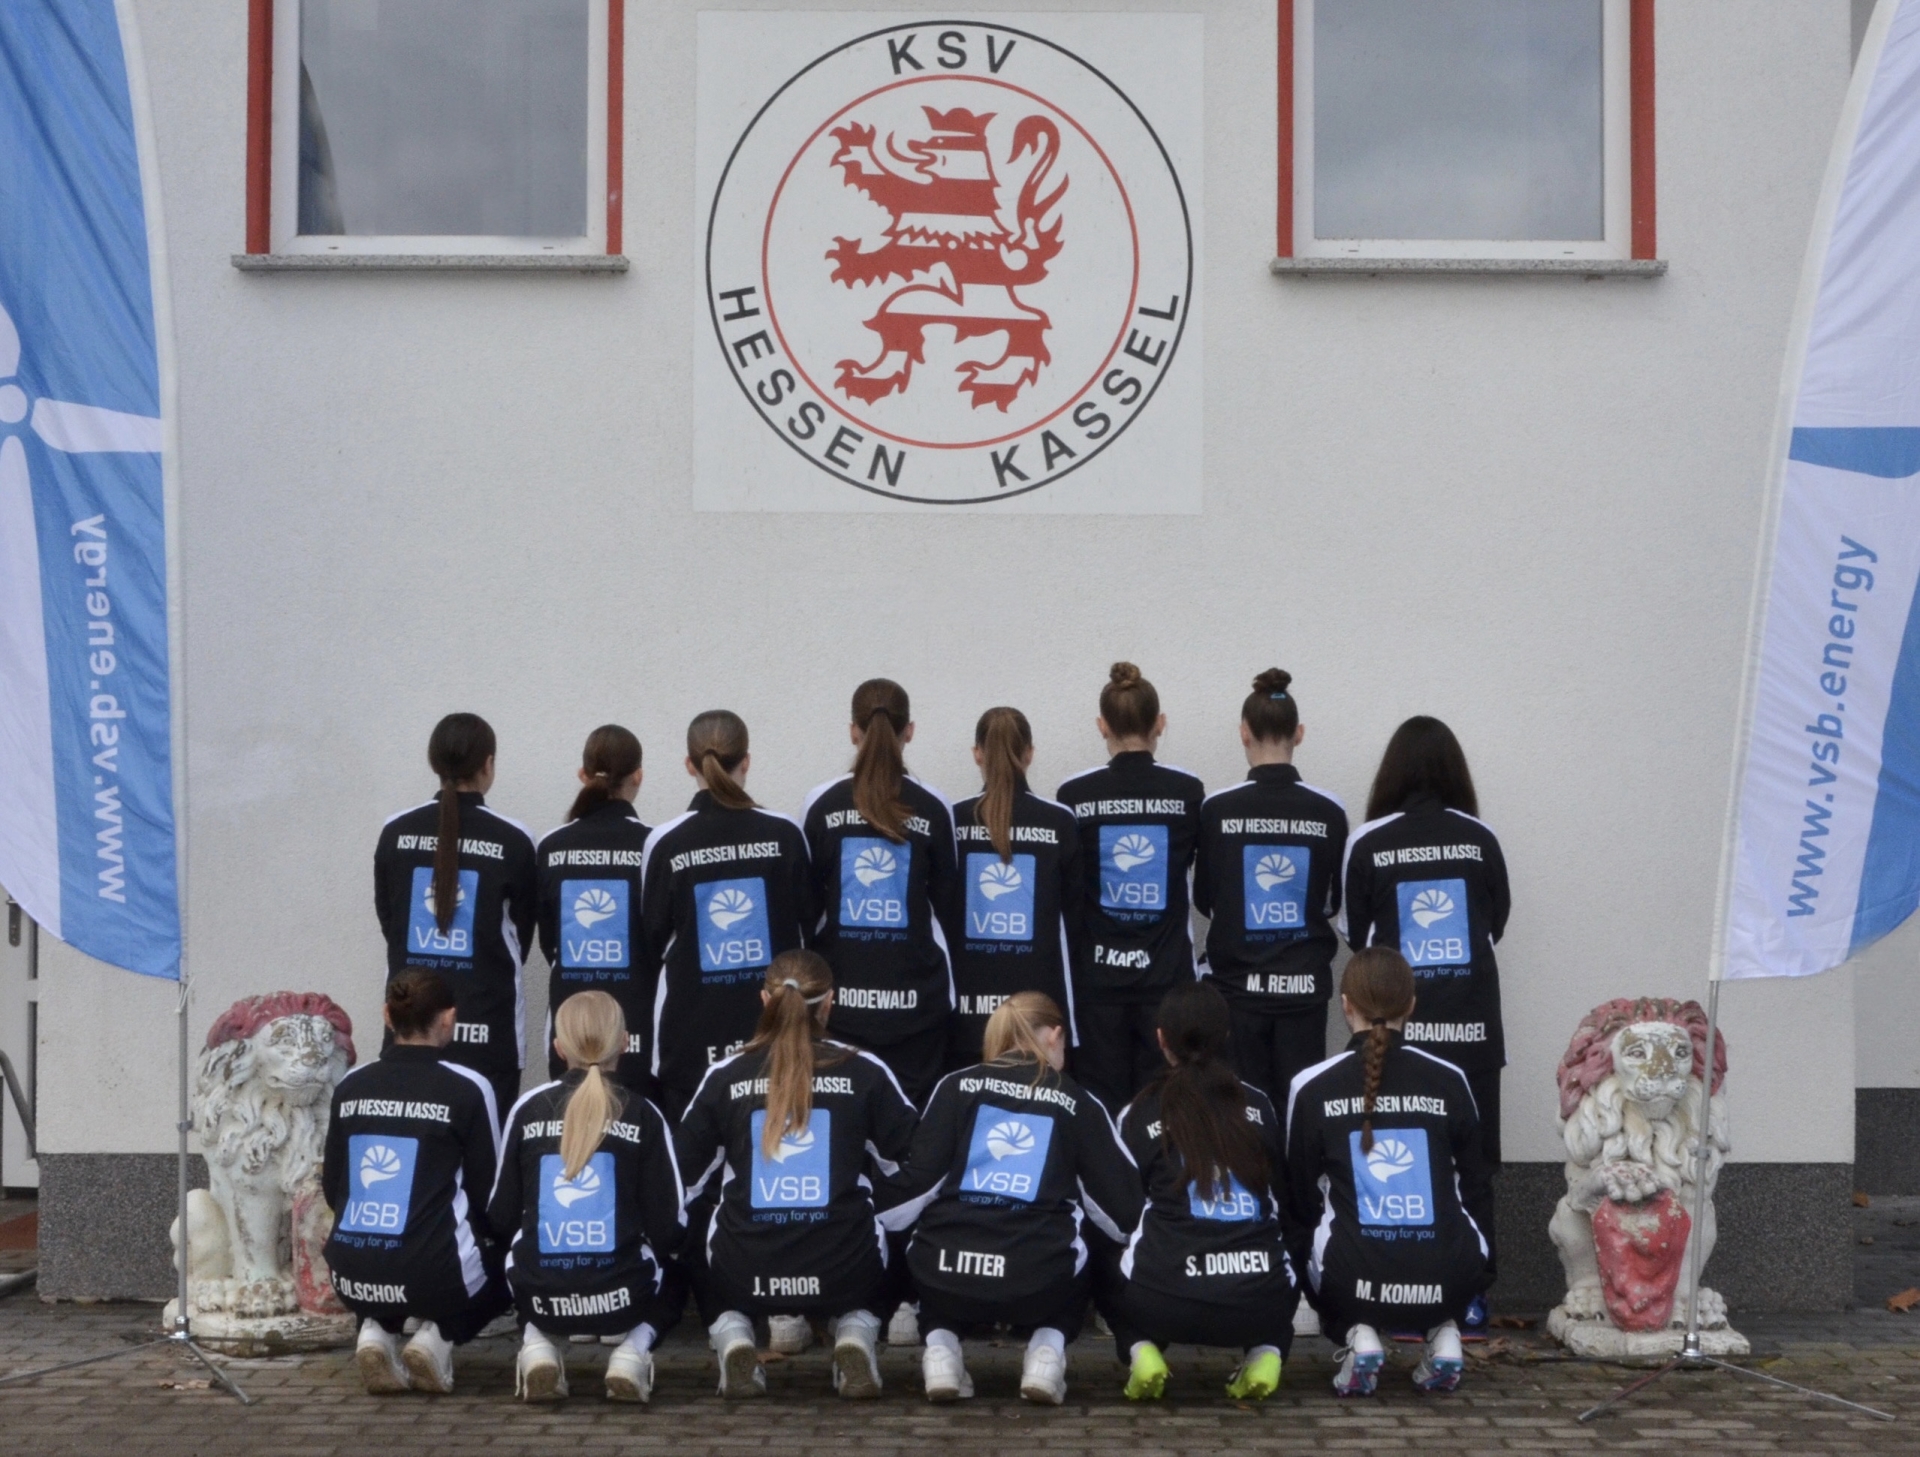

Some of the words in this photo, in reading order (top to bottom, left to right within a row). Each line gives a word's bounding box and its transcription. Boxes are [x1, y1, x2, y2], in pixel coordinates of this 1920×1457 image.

[887, 31, 1016, 75] KSV
[719, 286, 906, 487] HESSEN
[990, 294, 1180, 487] KASSEL
[1786, 535, 1878, 917] www.vsb.energy
[825, 811, 845, 829] KSV
[1075, 801, 1096, 818] KSV
[1097, 799, 1143, 815] HESSEN
[1145, 799, 1186, 815] KASSEL
[956, 826, 969, 841] SV
[1016, 826, 1059, 844] KASSEL
[1222, 819, 1243, 834] KSV
[1245, 819, 1288, 834] HESSEN
[1290, 819, 1328, 838] KASSEL
[397, 835, 419, 849] KSV
[462, 838, 505, 860] KASSEL
[549, 850, 566, 867] KSV
[567, 850, 611, 865] HESSEN
[612, 850, 642, 866] KASS
[670, 851, 690, 873] KSV
[690, 845, 736, 866] HESSEN
[738, 841, 782, 860] KASSEL
[1373, 851, 1395, 868] KSV
[1397, 846, 1441, 864] HESSEN
[1442, 844, 1483, 862] KASSEL
[1107, 882, 1159, 904] VSB
[847, 898, 902, 922] VSB
[1250, 902, 1298, 925] VSB
[973, 912, 1026, 935] VSB
[416, 926, 468, 951] VSB
[839, 930, 873, 941] energy
[874, 929, 889, 939] for
[891, 932, 908, 942] you
[567, 939, 623, 963] VSB
[706, 939, 764, 966] VSB
[965, 942, 997, 953] energy
[999, 942, 1015, 952] for
[1015, 943, 1033, 954] you
[1094, 945, 1104, 964] P.
[1407, 938, 1463, 962] VSB
[406, 957, 439, 969] energy
[440, 957, 454, 967] for
[456, 960, 473, 970] you
[1437, 966, 1452, 975] for
[1453, 968, 1471, 978] you
[561, 971, 594, 982] energy
[595, 970, 611, 980] for
[612, 972, 630, 982] you
[702, 973, 737, 984] energy
[738, 970, 758, 980] for
[760, 971, 772, 981] yo
[1246, 974, 1265, 993] M.
[1267, 974, 1315, 994] REMUS
[838, 987, 918, 1010] RODEWALD
[960, 995, 973, 1015] N.
[1404, 1022, 1487, 1042] BRAUNAGEL
[730, 1079, 752, 1100] KSV
[959, 1078, 984, 1093] KSV
[984, 1077, 1033, 1100] HESSEN
[1033, 1086, 1077, 1116] KASSEL
[340, 1100, 358, 1118] KSV
[357, 1098, 404, 1118] HESSEN
[404, 1101, 451, 1123] KASSEL
[1324, 1098, 1349, 1117] KSV
[1402, 1095, 1448, 1116] KASSEL
[523, 1121, 545, 1141] KSV
[759, 1176, 821, 1202] VSB
[972, 1168, 1032, 1194] VSB
[350, 1201, 400, 1228] VSB
[1202, 1192, 1255, 1217] VSB
[1364, 1195, 1426, 1220] VSB
[752, 1211, 789, 1224] energy
[790, 1210, 808, 1221] for
[808, 1211, 829, 1223] you
[333, 1232, 366, 1248] energy
[367, 1236, 383, 1247] for
[545, 1221, 606, 1247] VSB
[1399, 1228, 1416, 1239] for
[1417, 1230, 1436, 1241] you
[539, 1256, 575, 1270] energy
[576, 1255, 595, 1266] for
[938, 1249, 953, 1272] L.
[956, 1251, 1006, 1278] ITTER
[1185, 1255, 1202, 1277] S.
[1205, 1251, 1270, 1275] DONCEV
[339, 1276, 408, 1303] OLSCHOK
[752, 1276, 766, 1296] J.
[769, 1276, 821, 1297] PRIOR
[1356, 1279, 1376, 1302] M.
[1380, 1283, 1443, 1304] KOMMA
[532, 1296, 549, 1316] C.
[549, 1287, 631, 1317] TRÜMNER
